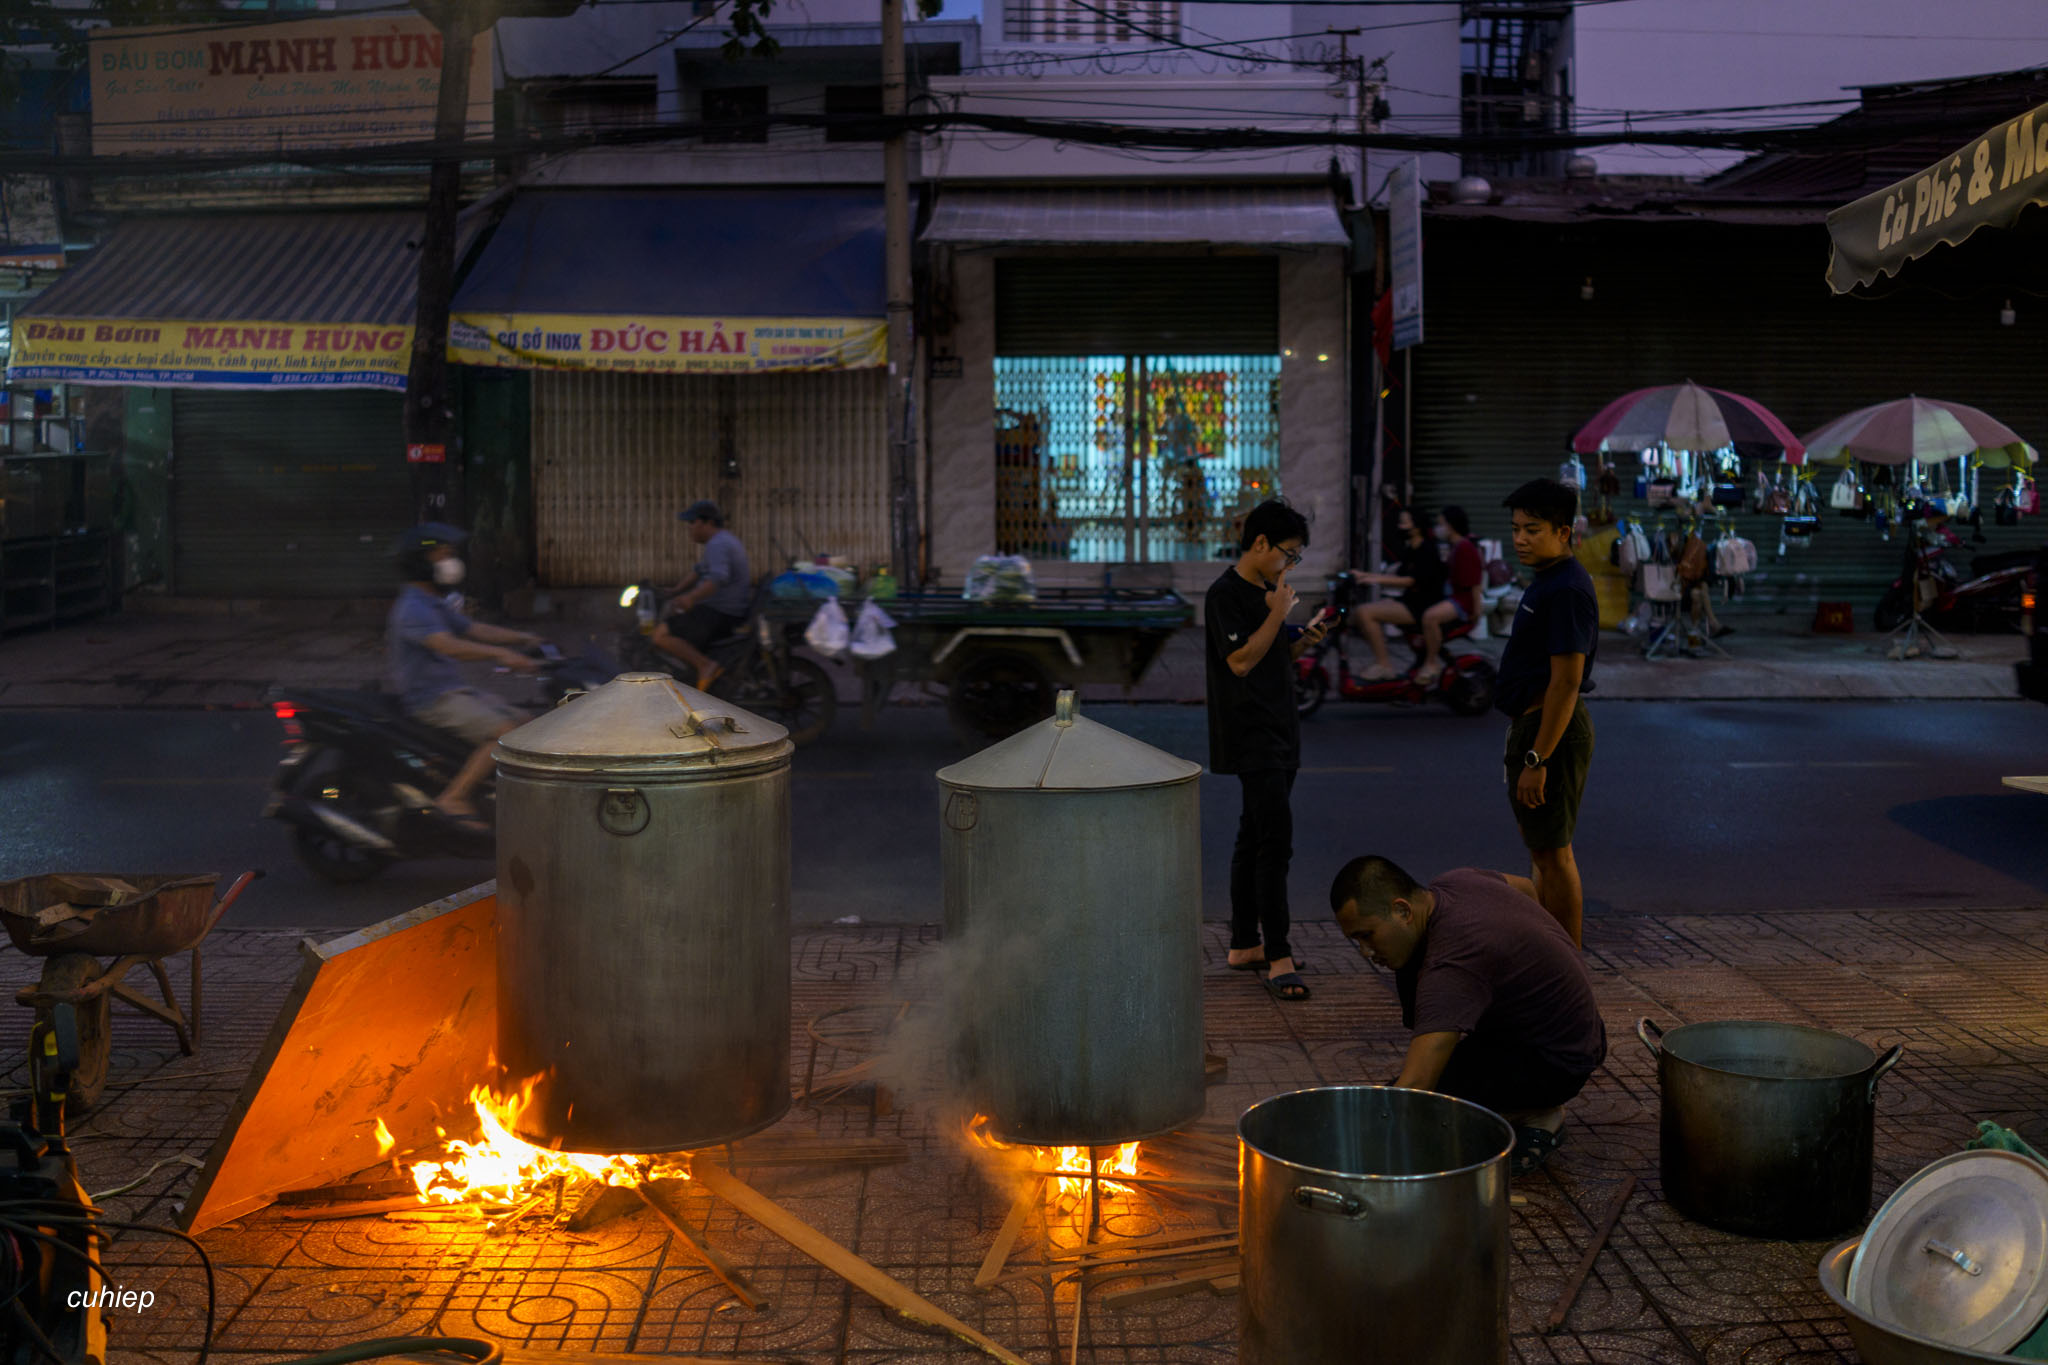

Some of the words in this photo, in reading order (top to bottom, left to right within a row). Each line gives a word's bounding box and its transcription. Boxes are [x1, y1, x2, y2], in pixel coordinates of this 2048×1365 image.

[208, 36, 336, 82] MẠNH
[352, 24, 474, 70] HÙN
[1878, 187, 1909, 251] Cà
[1909, 154, 1962, 235] Phê
[1967, 138, 1994, 206] &
[94, 324, 161, 343] Bơm
[183, 327, 294, 353] MẠNH
[522, 327, 544, 350] SỞ
[546, 332, 582, 351] INOX
[590, 322, 668, 353] ĐỨC
[678, 321, 747, 353] HẢI
